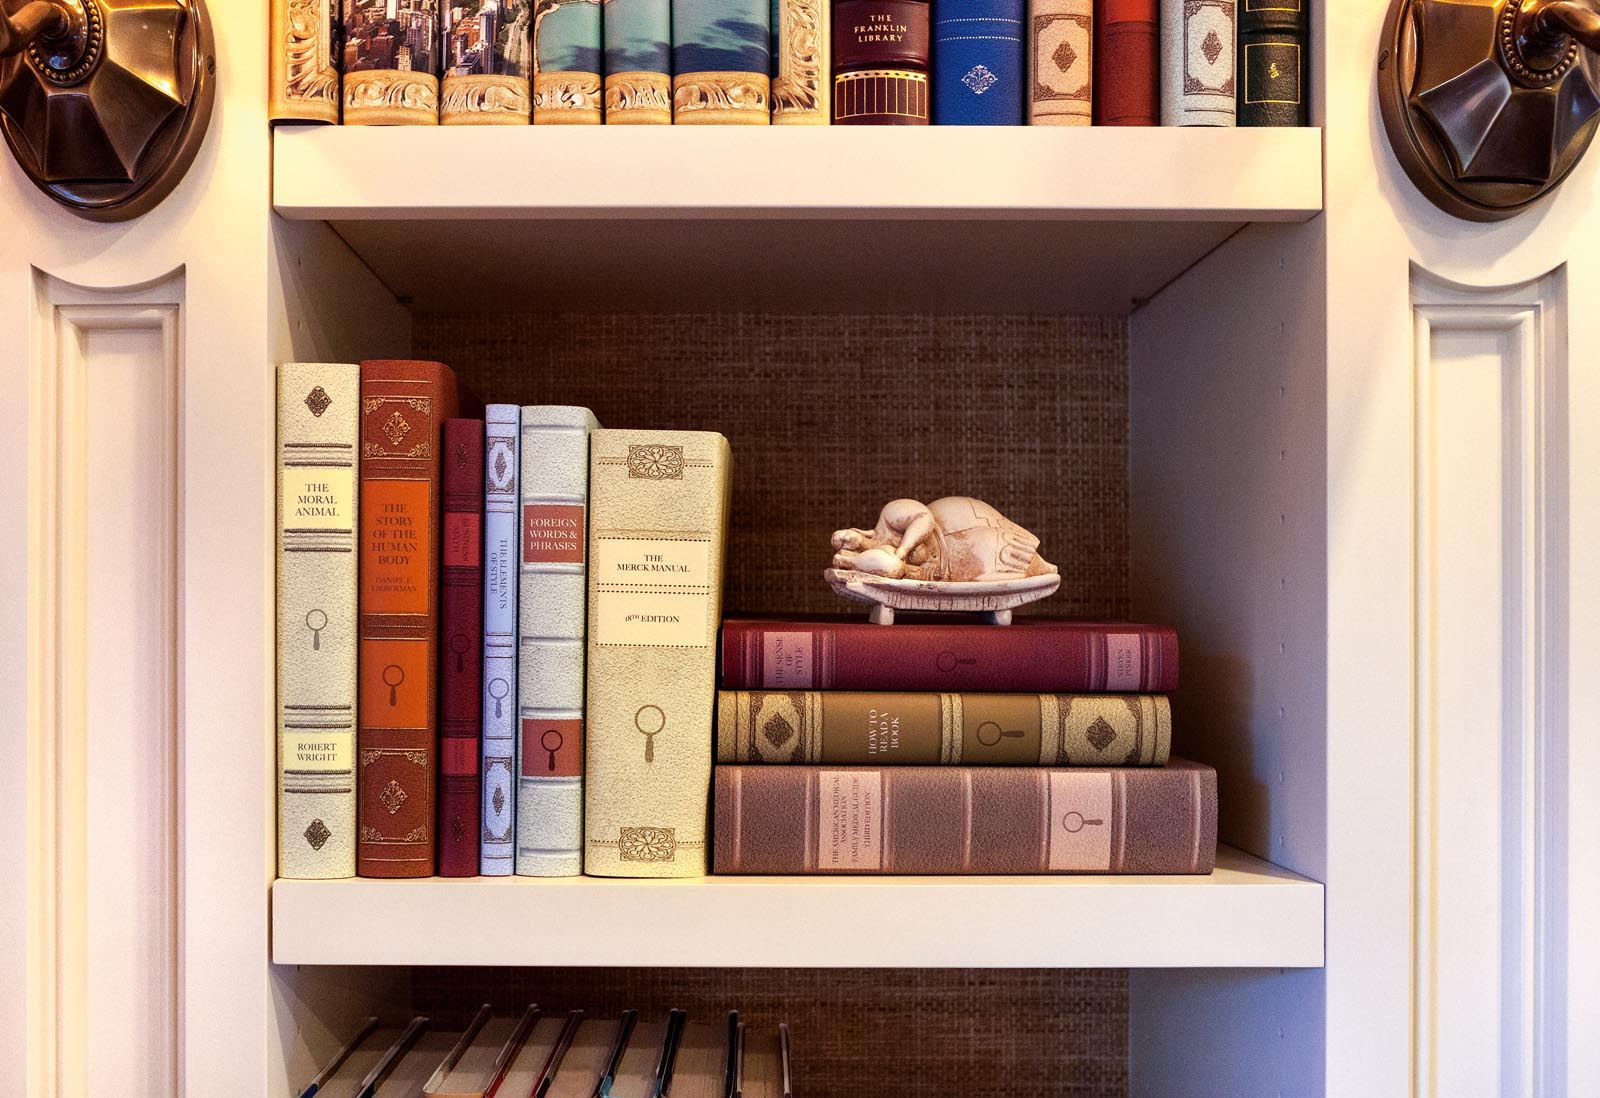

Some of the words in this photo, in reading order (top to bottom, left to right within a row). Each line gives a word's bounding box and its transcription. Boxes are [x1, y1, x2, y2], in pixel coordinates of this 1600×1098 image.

[869, 14, 892, 22] THE
[854, 24, 907, 34] FRANKLIN
[858, 34, 903, 43] LIBRARY
[304, 483, 329, 493] THE
[297, 495, 338, 505] MORAL
[295, 506, 340, 517] ANIMAL
[384, 503, 408, 513] THE
[375, 515, 415, 526] STORY
[530, 518, 577, 528] FOREIGN
[372, 529, 389, 540] OF
[391, 529, 417, 540] THE
[529, 529, 568, 539] WORDS
[569, 530, 577, 539] &
[370, 541, 418, 552] HUMAN
[499, 537, 508, 558] THE
[530, 541, 577, 551] PHRASES
[378, 555, 411, 566] BODY
[490, 552, 498, 565] OF
[643, 554, 664, 563] THE
[616, 563, 650, 572] MERCK
[650, 564, 691, 573] MANUAL
[490, 566, 498, 595] STYLE
[499, 559, 508, 609] ELEMENTS
[641, 615, 680, 623] EDITION
[775, 635, 784, 665] SENSE
[785, 652, 793, 667] OF
[795, 646, 803, 675] STYLE
[1116, 647, 1124, 678] STEVEN
[775, 666, 784, 685] THE
[868, 709, 878, 727] TO
[880, 712, 889, 721] A
[879, 721, 889, 752] READ
[890, 716, 900, 748] BOOK
[297, 742, 338, 751] ROBERT
[868, 728, 878, 754] HOW
[296, 753, 339, 762] WRIGHT
[831, 774, 840, 810] MEDICAL
[851, 776, 860, 800] GUIDE
[863, 792, 872, 824] EDITION
[840, 795, 848, 843] ASSOCIATION
[851, 801, 860, 836] MEDICAL
[831, 810, 840, 849] AMERICAN
[863, 825, 871, 848] THIRD
[831, 849, 840, 864] THE
[851, 836, 859, 863] FAMILY
